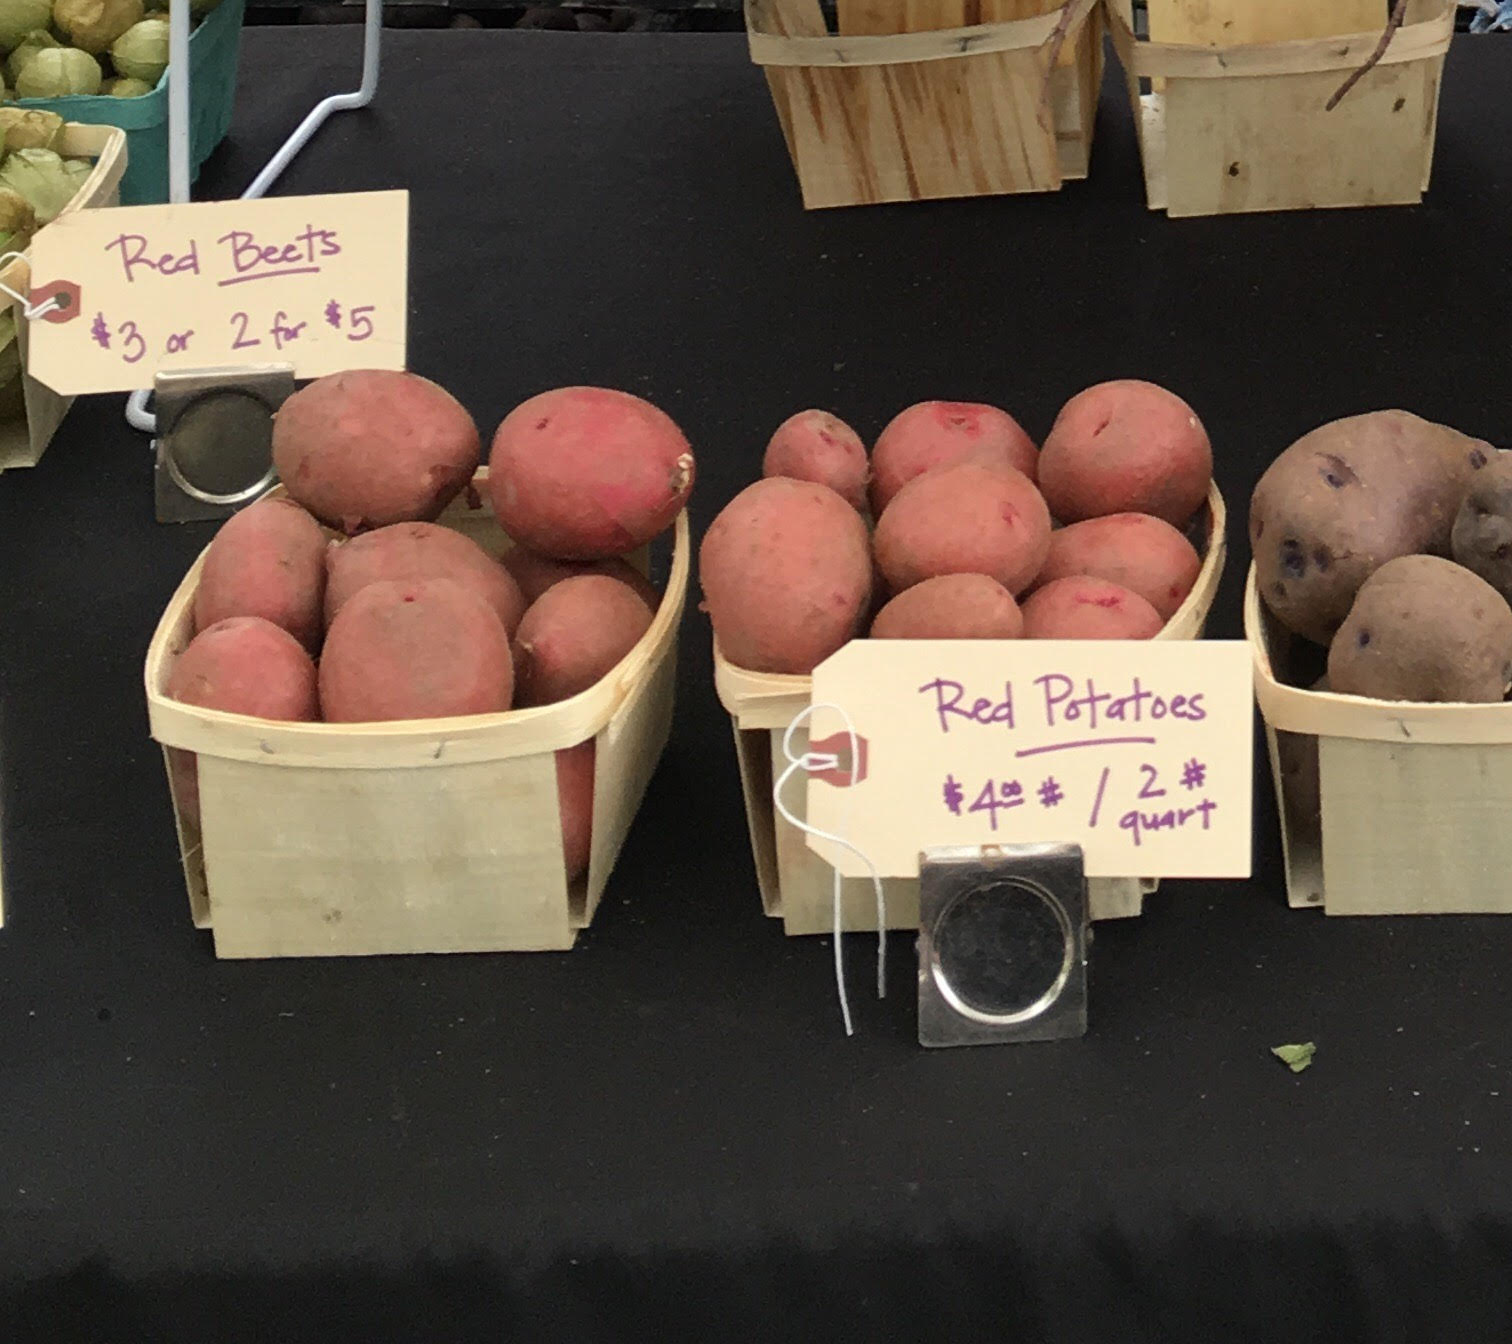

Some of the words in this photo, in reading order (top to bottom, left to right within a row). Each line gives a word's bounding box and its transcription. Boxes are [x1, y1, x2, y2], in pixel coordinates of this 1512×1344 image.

[104, 233, 201, 283] Red
[217, 223, 342, 274] Beets
[90, 311, 147, 364] $3
[166, 329, 195, 354] or
[230, 311, 262, 350] 2
[269, 310, 308, 351] for
[323, 299, 376, 342] $5
[918, 677, 1016, 734] Red
[1033, 673, 1208, 728] Potatoes
[1118, 799, 1218, 847] quart
